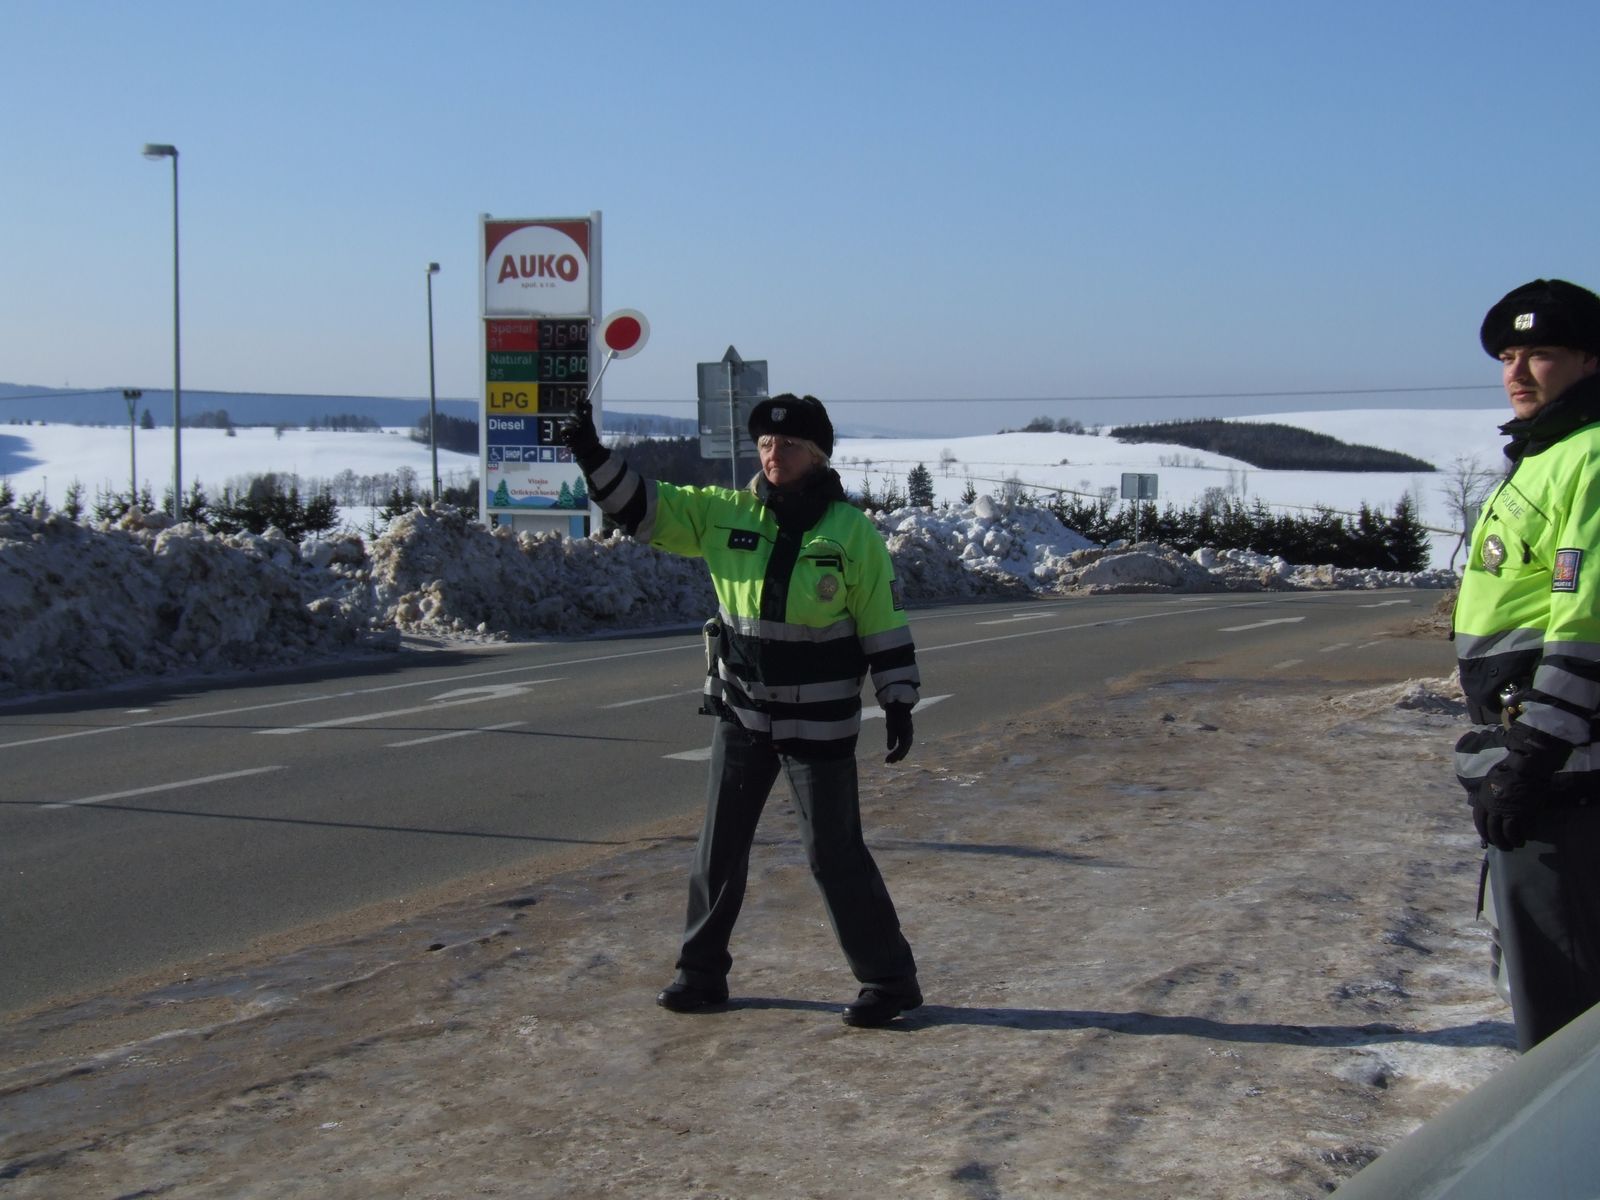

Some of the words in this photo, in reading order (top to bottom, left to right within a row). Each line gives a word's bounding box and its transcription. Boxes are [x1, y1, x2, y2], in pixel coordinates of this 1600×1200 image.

[497, 254, 579, 284] AUKO
[490, 353, 532, 365] Natural
[490, 391, 528, 409] LPG
[488, 418, 525, 430] Diesel
[1501, 489, 1525, 520] POLICIE
